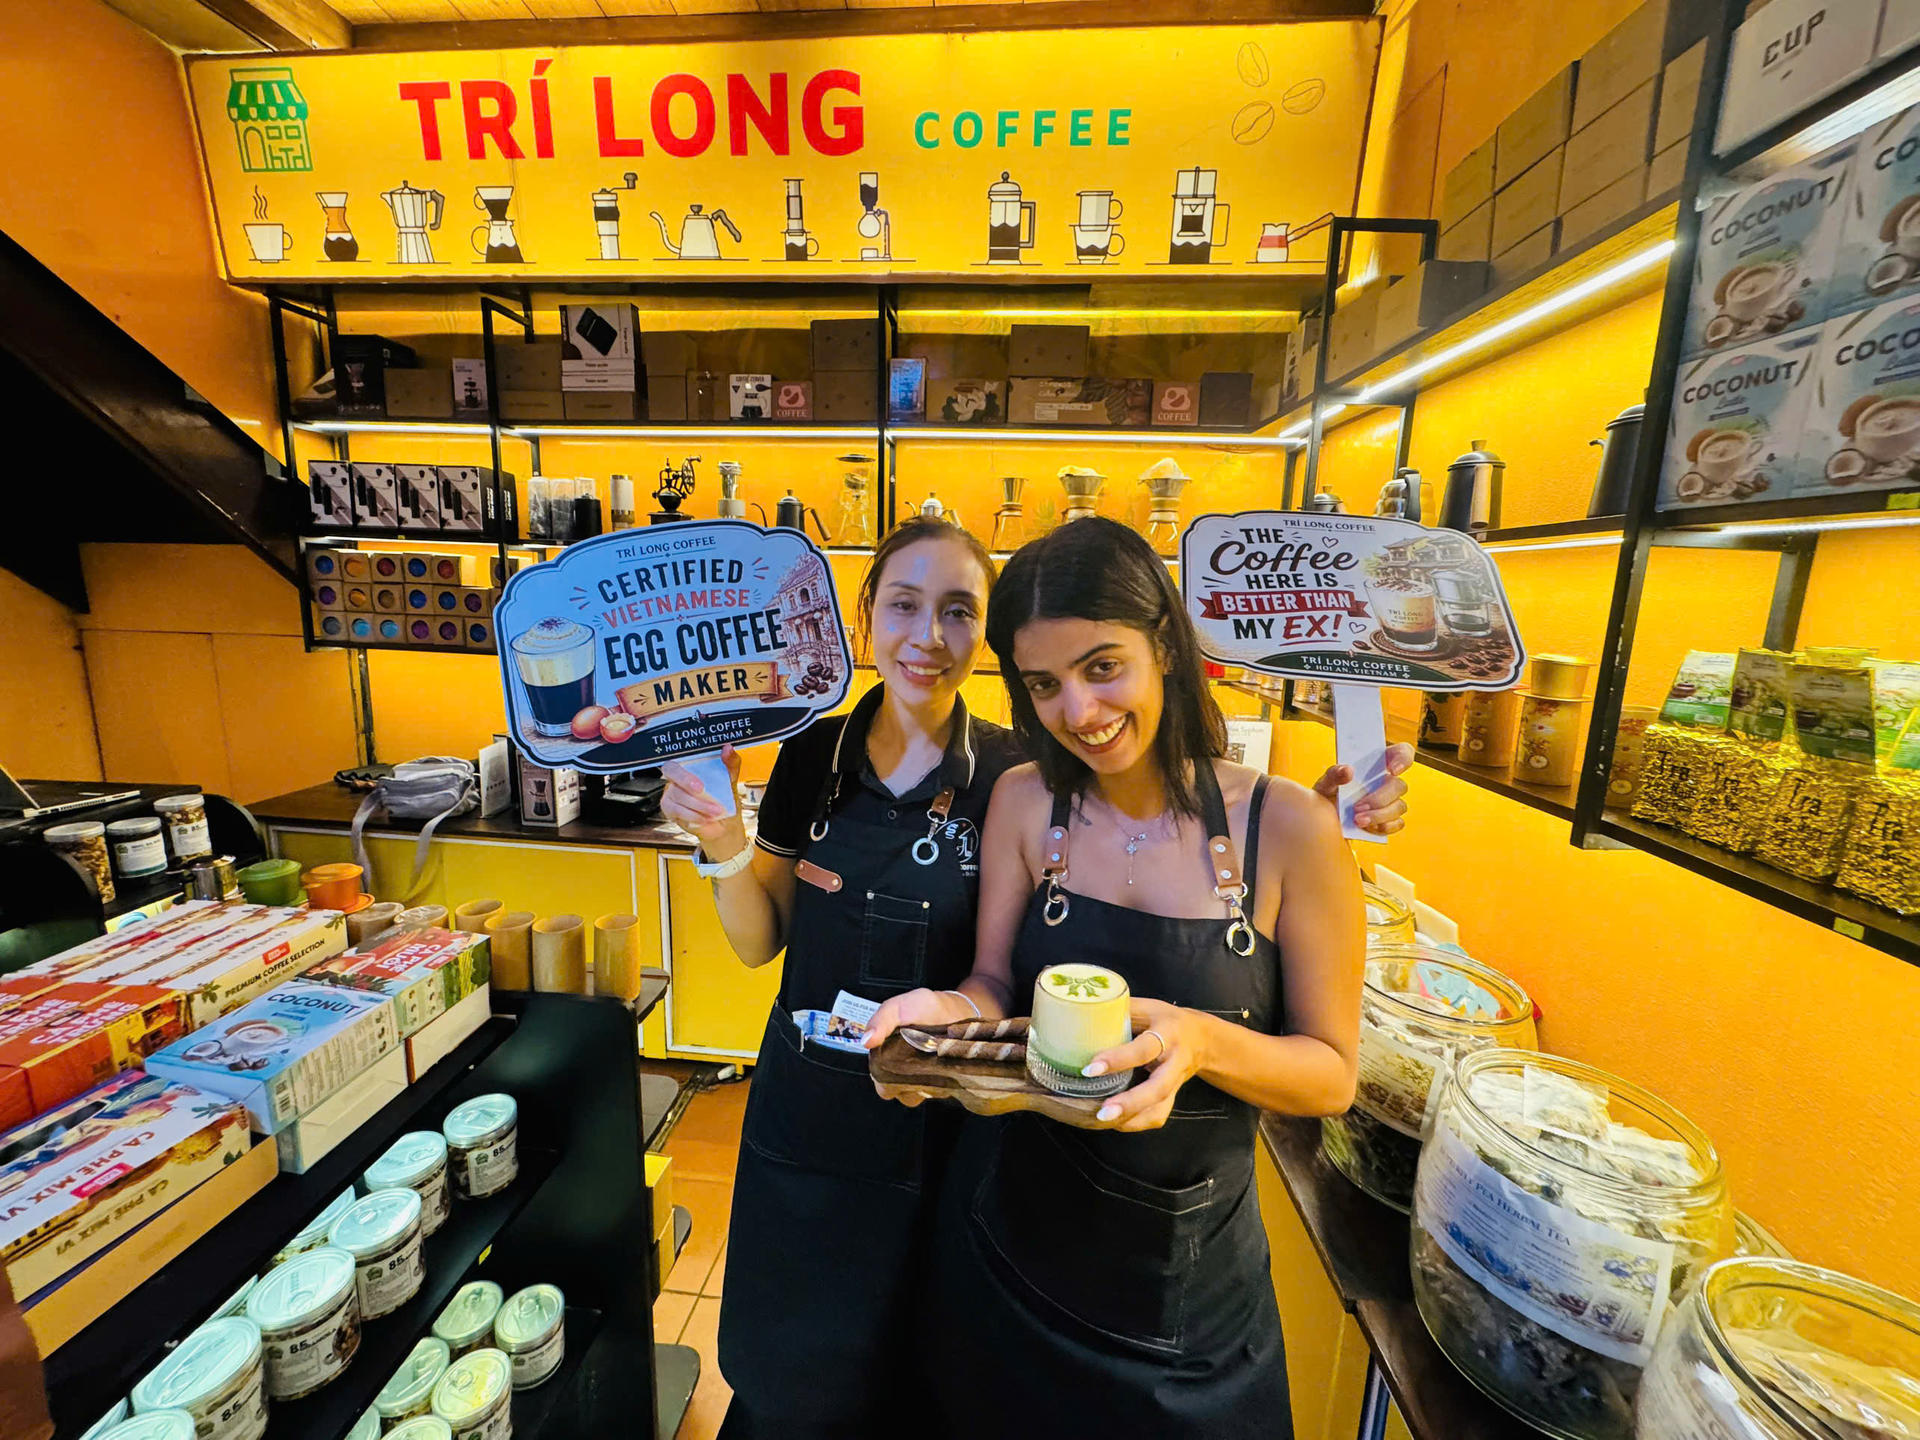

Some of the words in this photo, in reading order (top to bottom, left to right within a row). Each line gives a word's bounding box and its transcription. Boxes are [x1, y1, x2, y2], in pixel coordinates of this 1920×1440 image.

[1762, 9, 1827, 67] CUP
[399, 58, 555, 161] TRÍ
[593, 69, 864, 157] LONG
[914, 107, 1133, 148] COFFEE
[1711, 176, 1835, 246] COCONUT
[1683, 360, 1799, 404] COCONUT
[777, 409, 808, 417] COFFEE
[1157, 412, 1192, 421] COFFEE
[1239, 528, 1285, 545] THE
[1282, 519, 1301, 528] TRÍ
[1303, 519, 1333, 531] LONG
[1335, 521, 1376, 532] COFFEE
[616, 545, 636, 559] TRÍ
[639, 542, 671, 556] LONG
[673, 536, 716, 551] COFFEE
[1209, 540, 1360, 576] Coffee
[597, 558, 745, 605] CERTIFIED
[1245, 573, 1307, 590] HERE
[1314, 572, 1337, 588] IS
[602, 588, 750, 630] VIETNAMESE
[1223, 592, 1303, 613] BETTER
[1305, 591, 1351, 609] THAN
[1233, 618, 1275, 640] MY
[1281, 614, 1342, 640] EX!
[604, 628, 670, 680] EGG
[676, 608, 789, 666] COFFEE
[1301, 655, 1322, 666] TRÍ
[1326, 658, 1359, 669] LONG
[1362, 661, 1411, 674] COFFEE
[1315, 664, 1333, 672] HOI
[1354, 667, 1398, 678] VIETNAM
[653, 668, 749, 706] MAKER
[652, 731, 672, 745] TRÍ
[675, 726, 706, 742] LONG
[709, 717, 752, 736] COFFEE
[664, 742, 682, 753] HOI
[702, 730, 744, 747] VIETNAM
[224, 974, 262, 998] PREMIUM
[263, 958, 290, 977] COFFEE
[289, 938, 325, 963] SELECTION
[267, 993, 361, 1015] COCONUT
[31, 1176, 78, 1204] MIX
[1497, 1199, 1543, 1232] HERBAL
[1548, 1228, 1571, 1247] TEA
